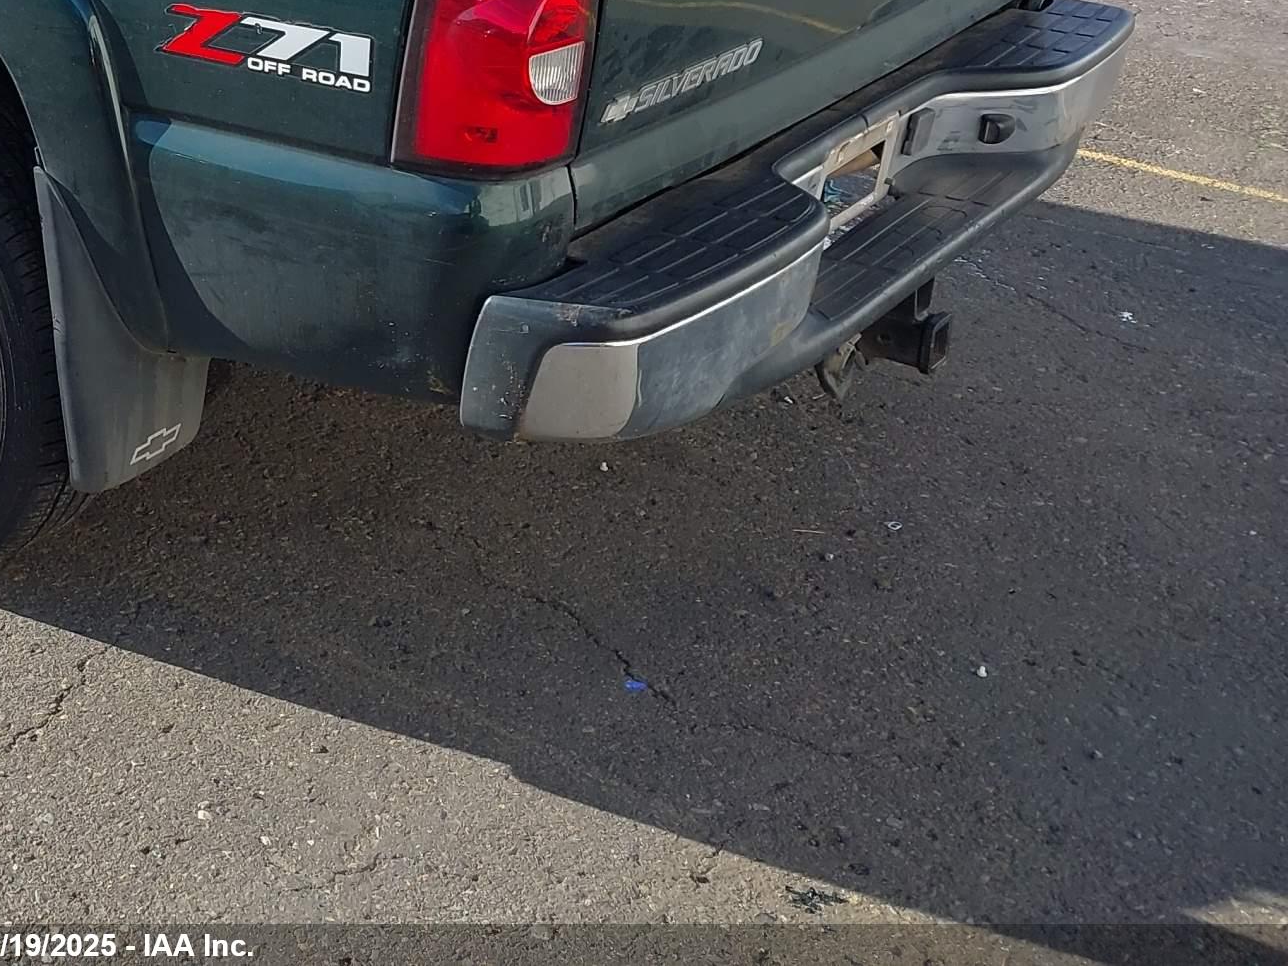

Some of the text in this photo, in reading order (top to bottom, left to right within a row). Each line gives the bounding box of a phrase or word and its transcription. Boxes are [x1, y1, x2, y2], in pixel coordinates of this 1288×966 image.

[160, 2, 372, 78] Z71
[247, 56, 372, 94] OFF ROAD
[634, 37, 764, 113] SILVERADO
